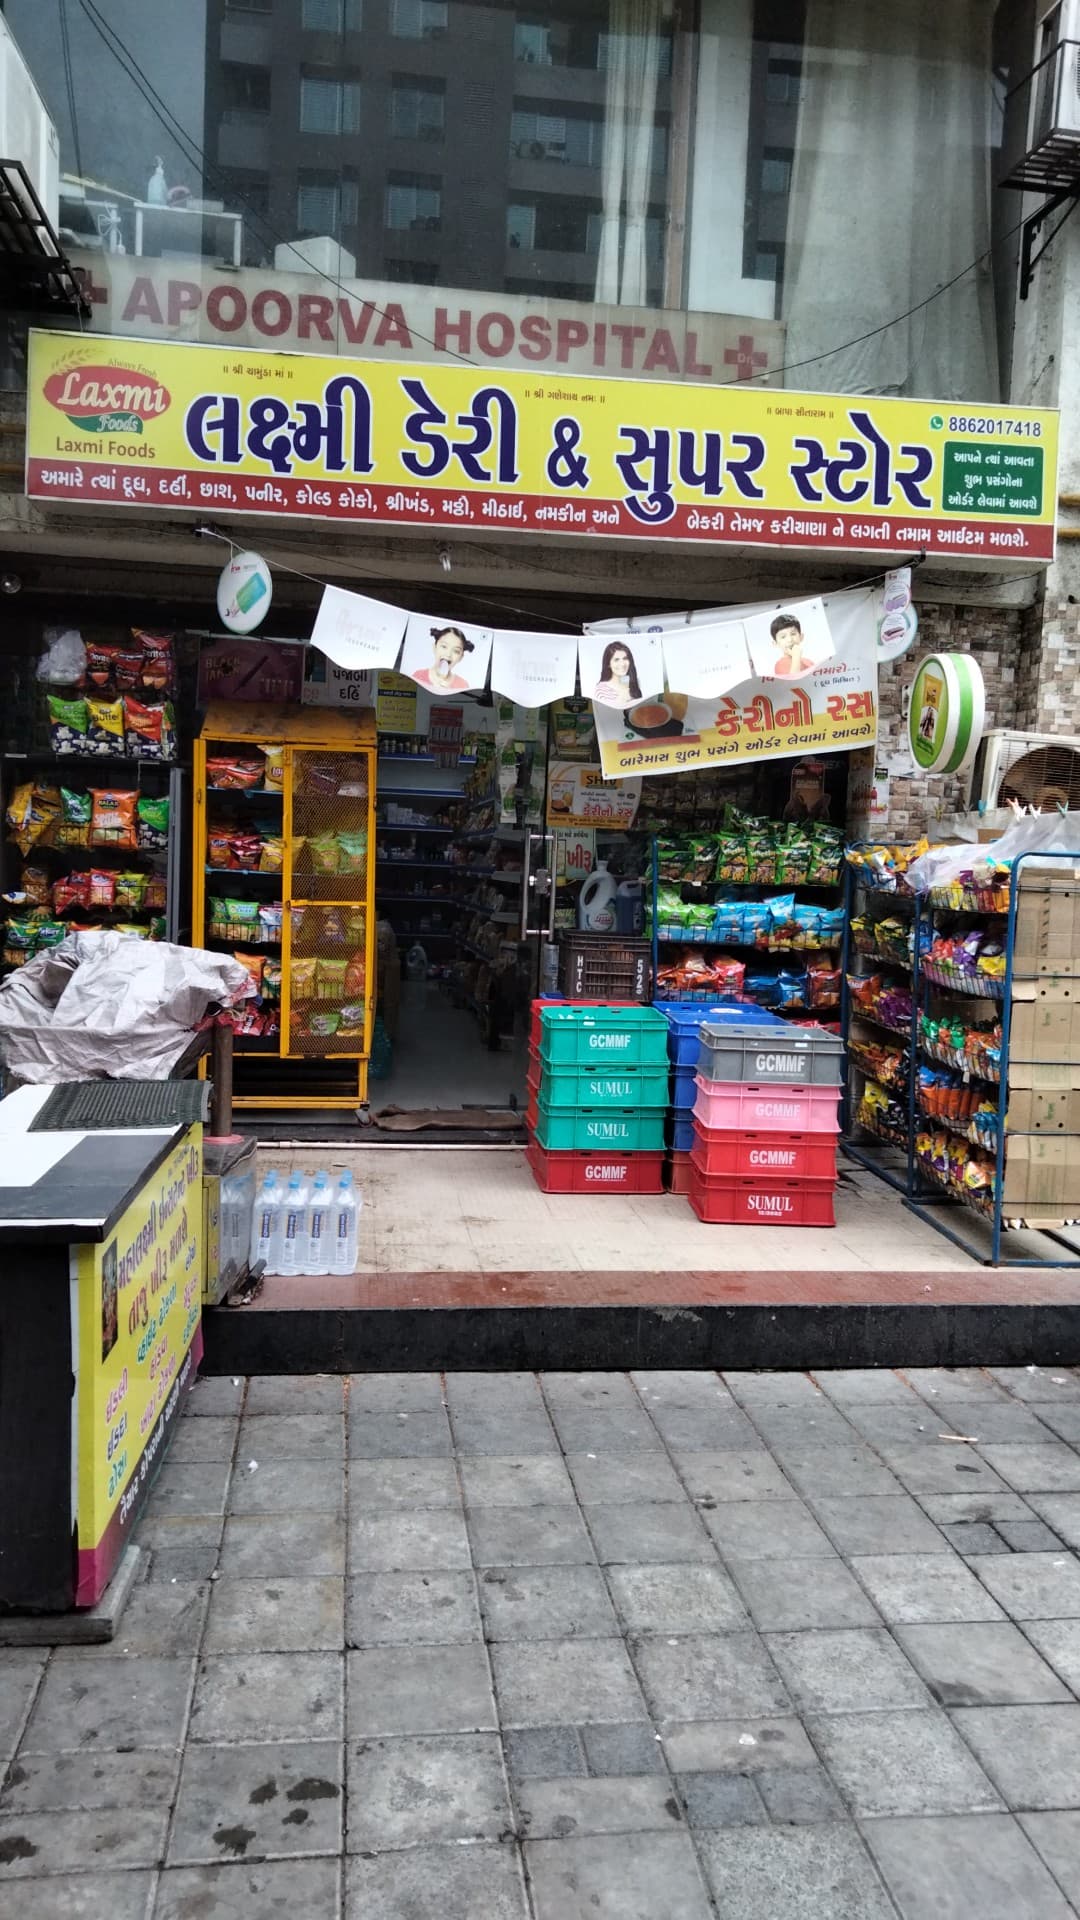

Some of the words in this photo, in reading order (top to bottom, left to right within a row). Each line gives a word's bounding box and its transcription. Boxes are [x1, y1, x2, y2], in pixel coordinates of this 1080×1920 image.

[121, 276, 413, 349] APOORVA
[434, 307, 713, 377] HOSPITAL
[57, 372, 166, 413] Laxmi
[97, 414, 139, 433] Foods
[949, 416, 1041, 437] 8862017418
[56, 436, 103, 454] Laxmi
[108, 440, 156, 459] Foods
[186, 376, 374, 474] લક્ષ્મી
[400, 379, 519, 483] ડેરી
[547, 418, 589, 489] &
[616, 427, 764, 523] સુપર
[791, 412, 932, 508] સ્ટોર
[954, 450, 982, 463] આપને
[1004, 456, 1035, 467] આવતા
[964, 474, 982, 488] શુભ
[986, 472, 1023, 487] પ્રસંગોના
[40, 466, 84, 487] અમારે
[91, 469, 116, 490] ત્યાં
[122, 475, 151, 498] દૂધ,
[199, 482, 237, 503] છાશ,
[245, 483, 289, 506] પનીર,
[296, 484, 332, 506] કોલ્ડ
[338, 487, 377, 512] કોકો,
[385, 491, 435, 517] શ્રીખંડ,
[482, 498, 528, 522] મીઠાઈ,
[535, 503, 586, 523] નમકીન
[592, 505, 620, 525] અને
[687, 509, 725, 531] બેકરી
[730, 511, 765, 533] તેમજ
[770, 516, 827, 537] કરીયાણા
[832, 517, 845, 537] ને
[850, 521, 891, 541] લગતી
[896, 527, 931, 543] તમામ
[937, 526, 984, 545] આઈટમ
[989, 528, 1030, 548] મળશે.
[948, 491, 974, 506] ઓર્ડર
[977, 492, 1006, 508] લેવામાં
[1008, 496, 1037, 509] આવશે
[714, 688, 813, 737] કેરીનો
[826, 690, 874, 722] રસ
[620, 753, 669, 767] બારેમાસ
[675, 749, 701, 764] શુભ
[707, 741, 740, 756] પ્રસંગે
[745, 736, 781, 751] ઓર્ડર
[787, 728, 826, 745] લેવામાં
[589, 1034, 631, 1049] GCMMF
[756, 1054, 806, 1072] GCMMF
[590, 1081, 633, 1096] SUMUL
[755, 1103, 800, 1117] GCMMF
[587, 1122, 629, 1137] SUMUL
[750, 1150, 797, 1165] GCMMF
[585, 1165, 627, 1179] GCMMF
[747, 1194, 793, 1211] SUMUL
